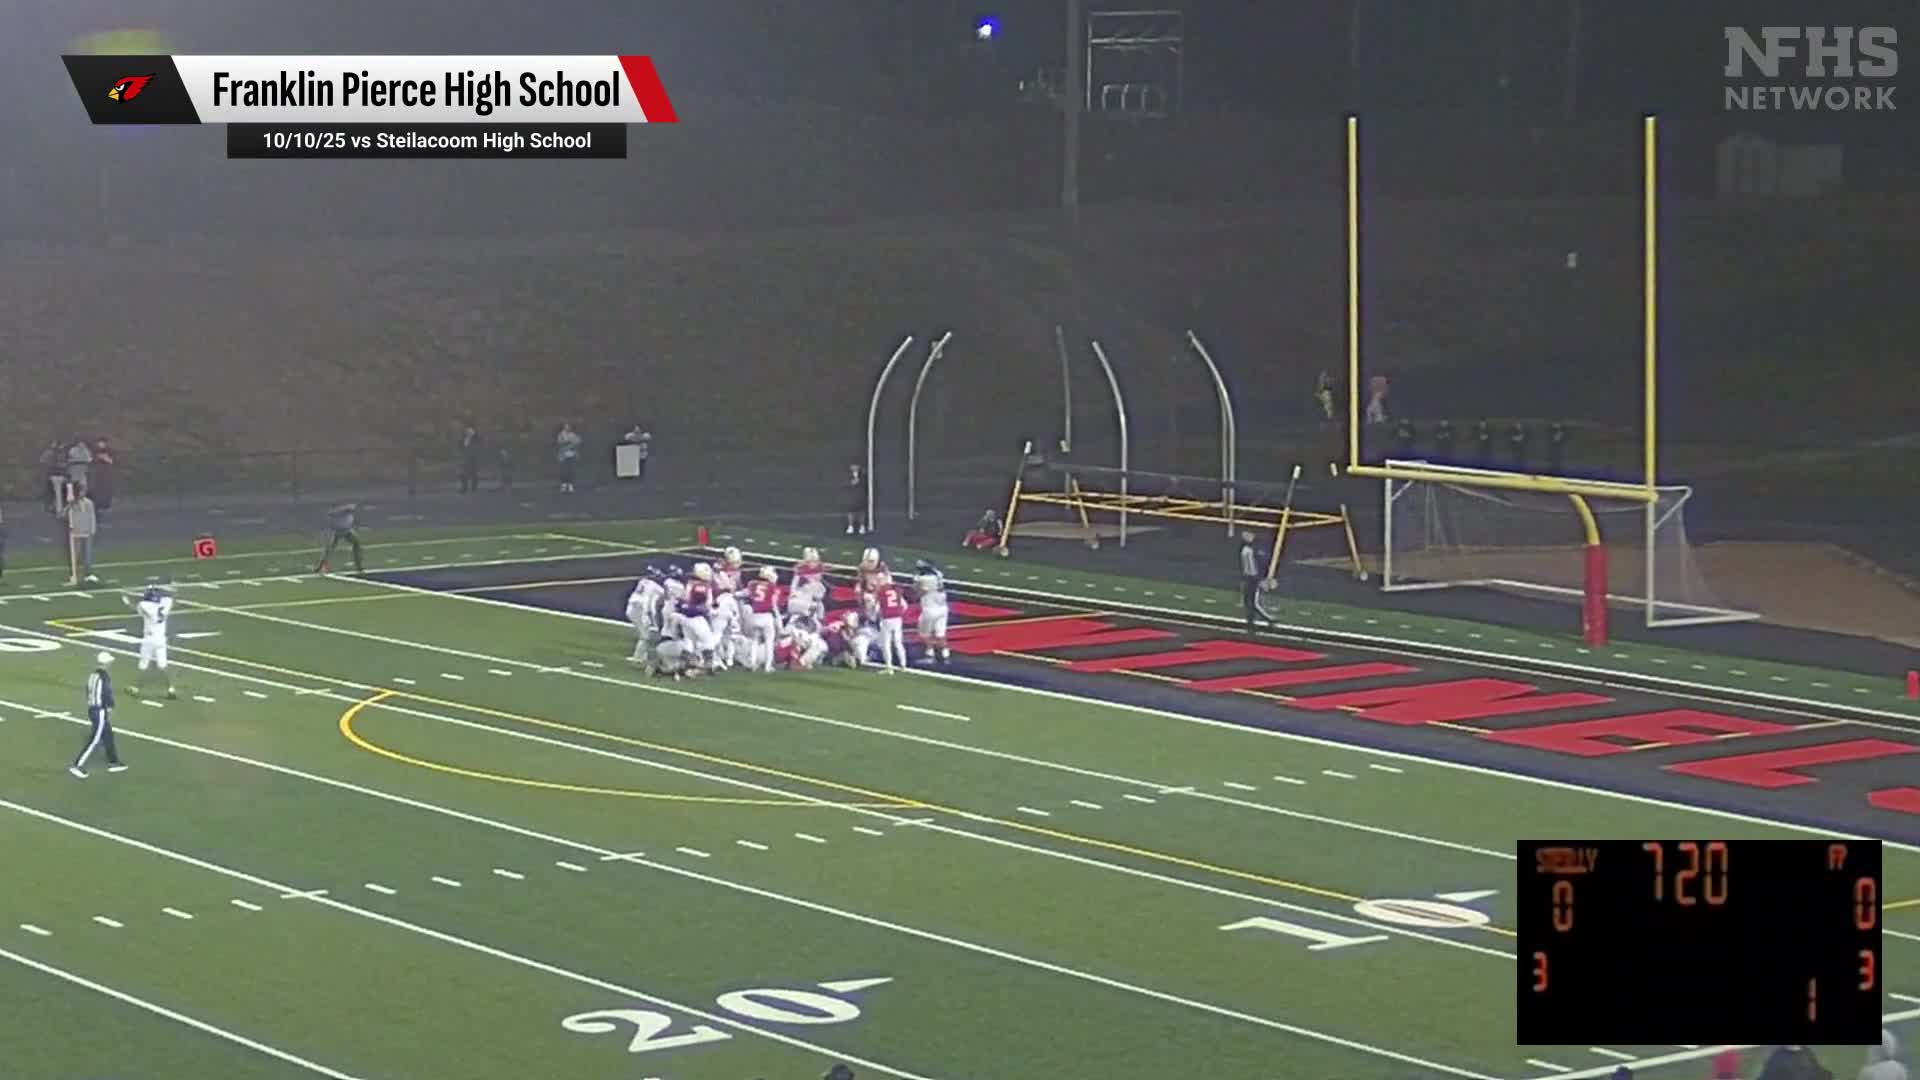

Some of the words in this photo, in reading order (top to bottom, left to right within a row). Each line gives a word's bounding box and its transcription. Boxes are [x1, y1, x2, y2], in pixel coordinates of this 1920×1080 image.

[755, 585, 766, 601] 5
[1552, 880, 1574, 932] 0
[1854, 877, 1876, 931] 0
[1532, 951, 1548, 993] 3
[1858, 949, 1875, 991] 3
